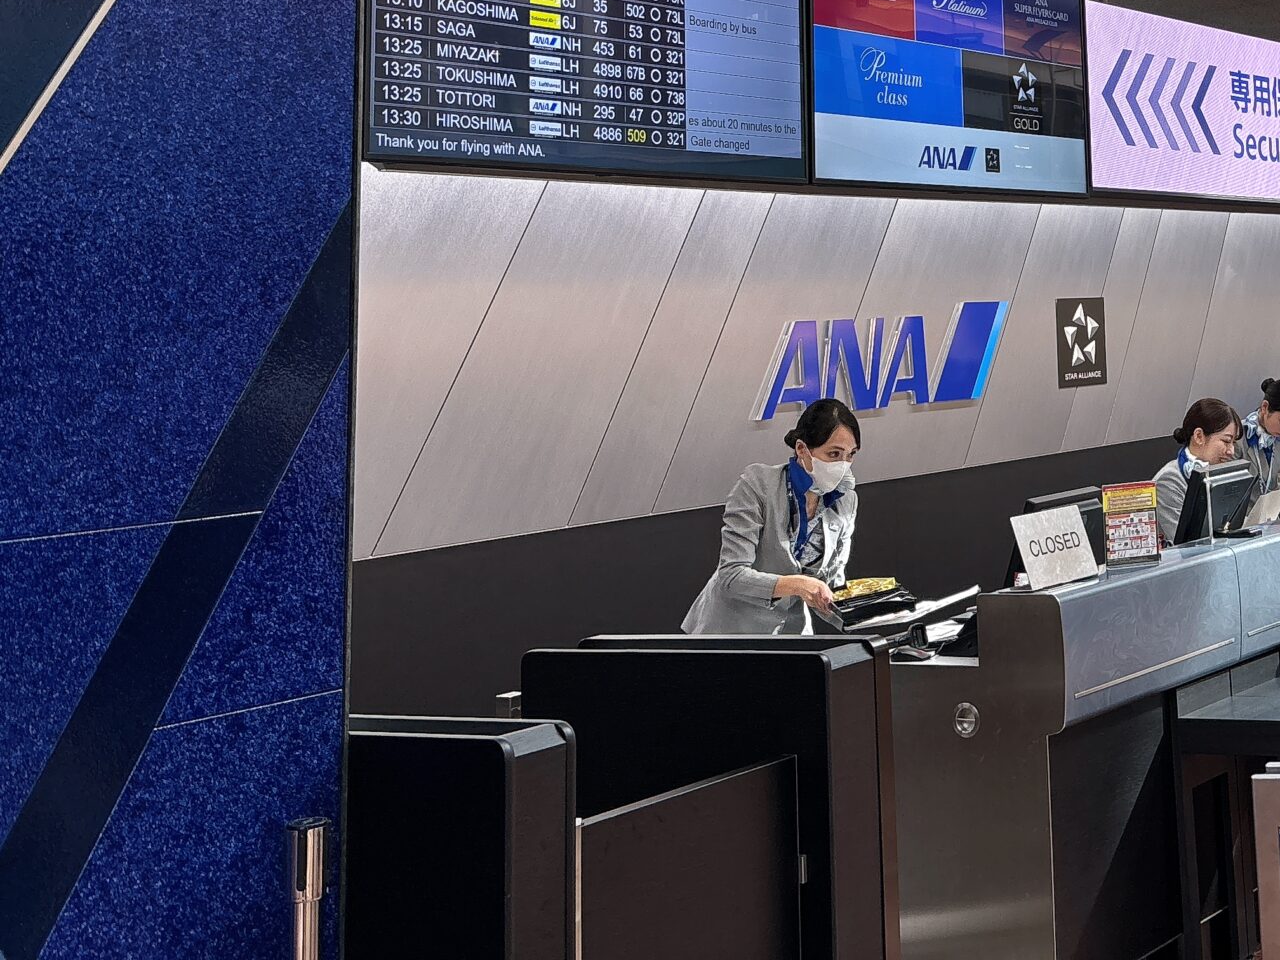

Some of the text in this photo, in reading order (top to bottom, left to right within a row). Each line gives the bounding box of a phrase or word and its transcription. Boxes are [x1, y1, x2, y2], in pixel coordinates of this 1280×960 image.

[593, 0, 607, 13] 35
[626, 4, 645, 19] 502
[384, 13, 642, 59] 13:15 SAGA NH 453 61
[562, 16, 576, 30] 6J
[593, 20, 607, 34] 75
[629, 25, 642, 39] 53
[690, 14, 757, 35] Boarding by bus
[383, 36, 645, 80] 13:25 MIYAZAKI LH 4898 67B
[860, 47, 923, 88] Premium
[382, 60, 643, 101] 13:25 TOKUSHIMA LH 4910 66
[382, 85, 643, 122] 13:25 TOTTORI NH 295 47
[877, 86, 908, 106] class
[382, 108, 646, 143] 13:30 HIROSHIMA LH 4886 509
[702, 117, 796, 134] about 20 minutes to the
[1014, 118, 1039, 131] GOLD
[376, 133, 546, 157] Thank you for flying with ANA.
[690, 136, 750, 152] Gate changed
[919, 146, 957, 170] ANA
[750, 315, 929, 420] ANA
[1064, 370, 1102, 381] STAR ALLIANCE
[1029, 531, 1080, 557] CLOSED
